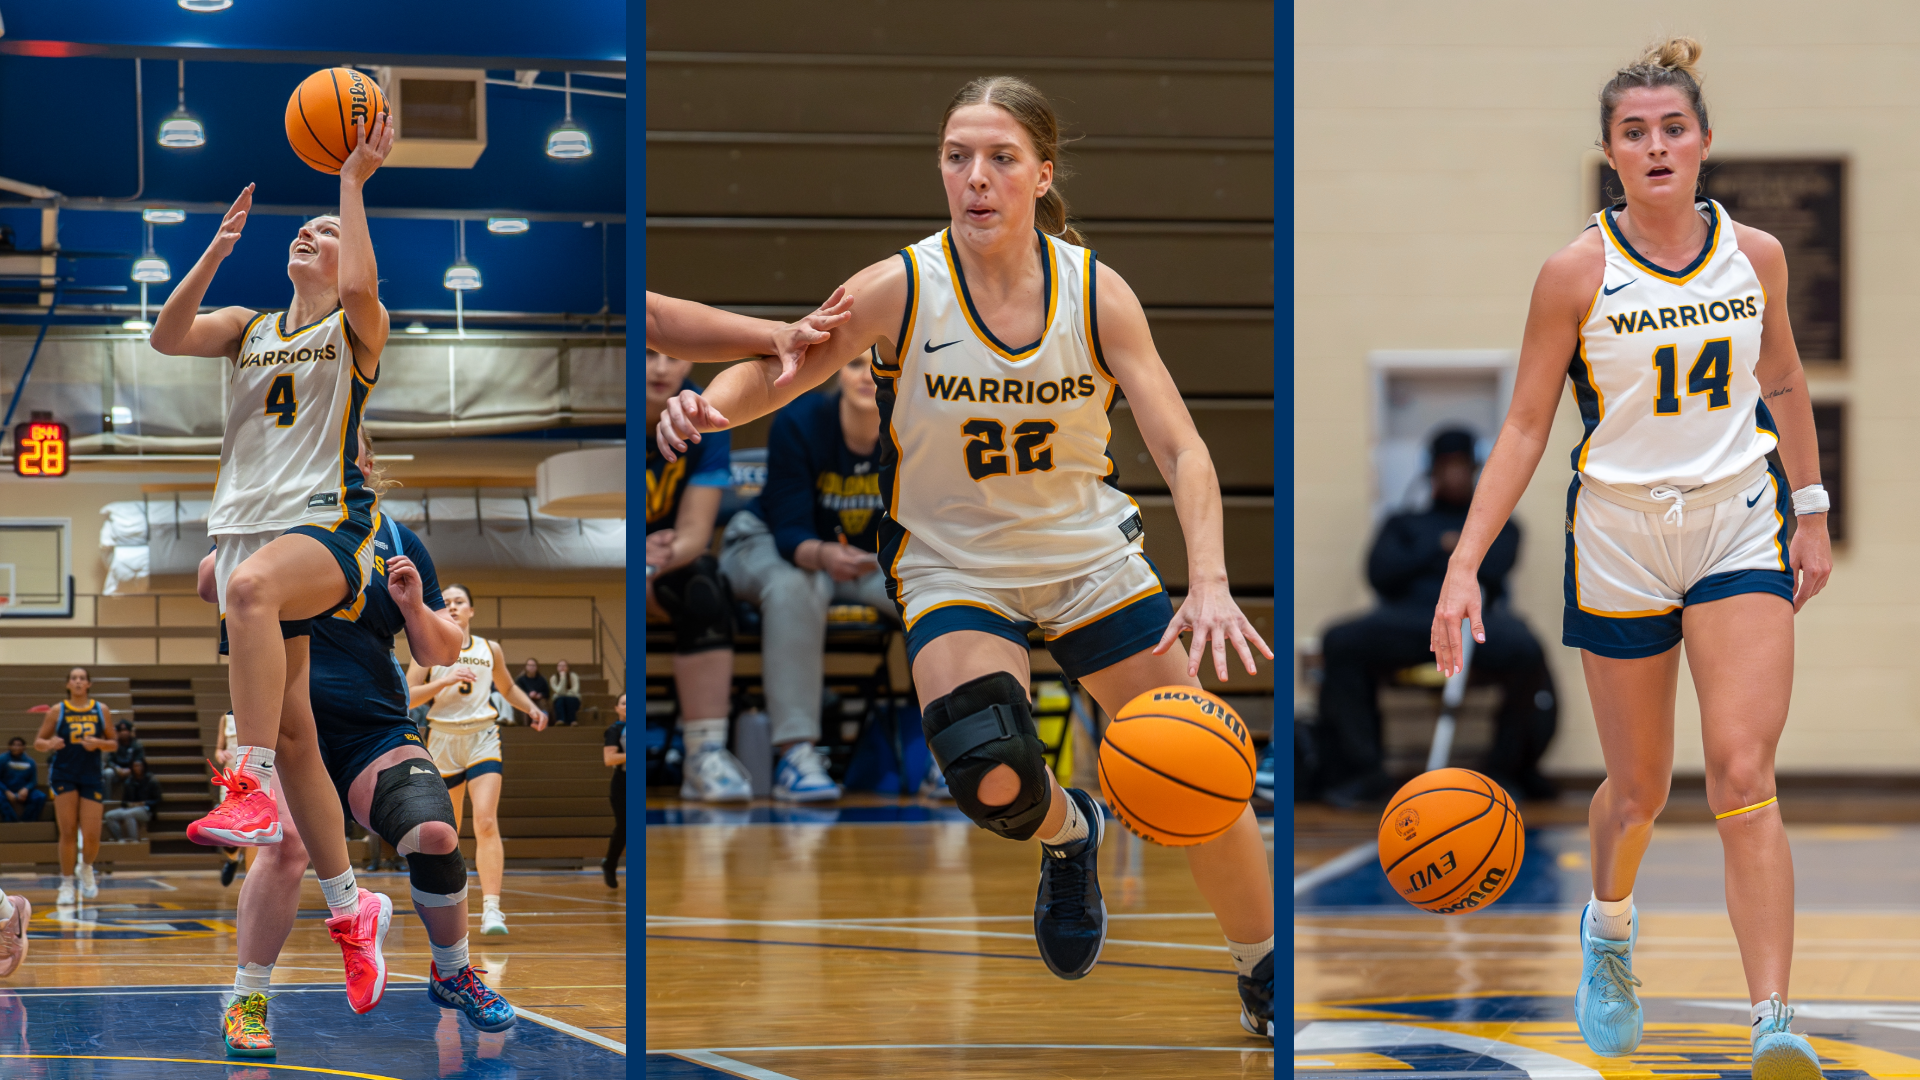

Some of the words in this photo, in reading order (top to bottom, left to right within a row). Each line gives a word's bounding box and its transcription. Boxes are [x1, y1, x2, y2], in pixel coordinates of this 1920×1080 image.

[347, 69, 369, 126] Wilson
[1606, 295, 1758, 335] WARRIORS
[264, 373, 299, 428] 4
[924, 372, 1097, 405] WARRIORS
[1651, 336, 1734, 416] 14
[19, 439, 65, 475] 28
[960, 417, 1060, 483] 22
[457, 656, 490, 667] RRIORS
[1153, 691, 1247, 747] Wilson
[1422, 867, 1508, 914] Wilson
